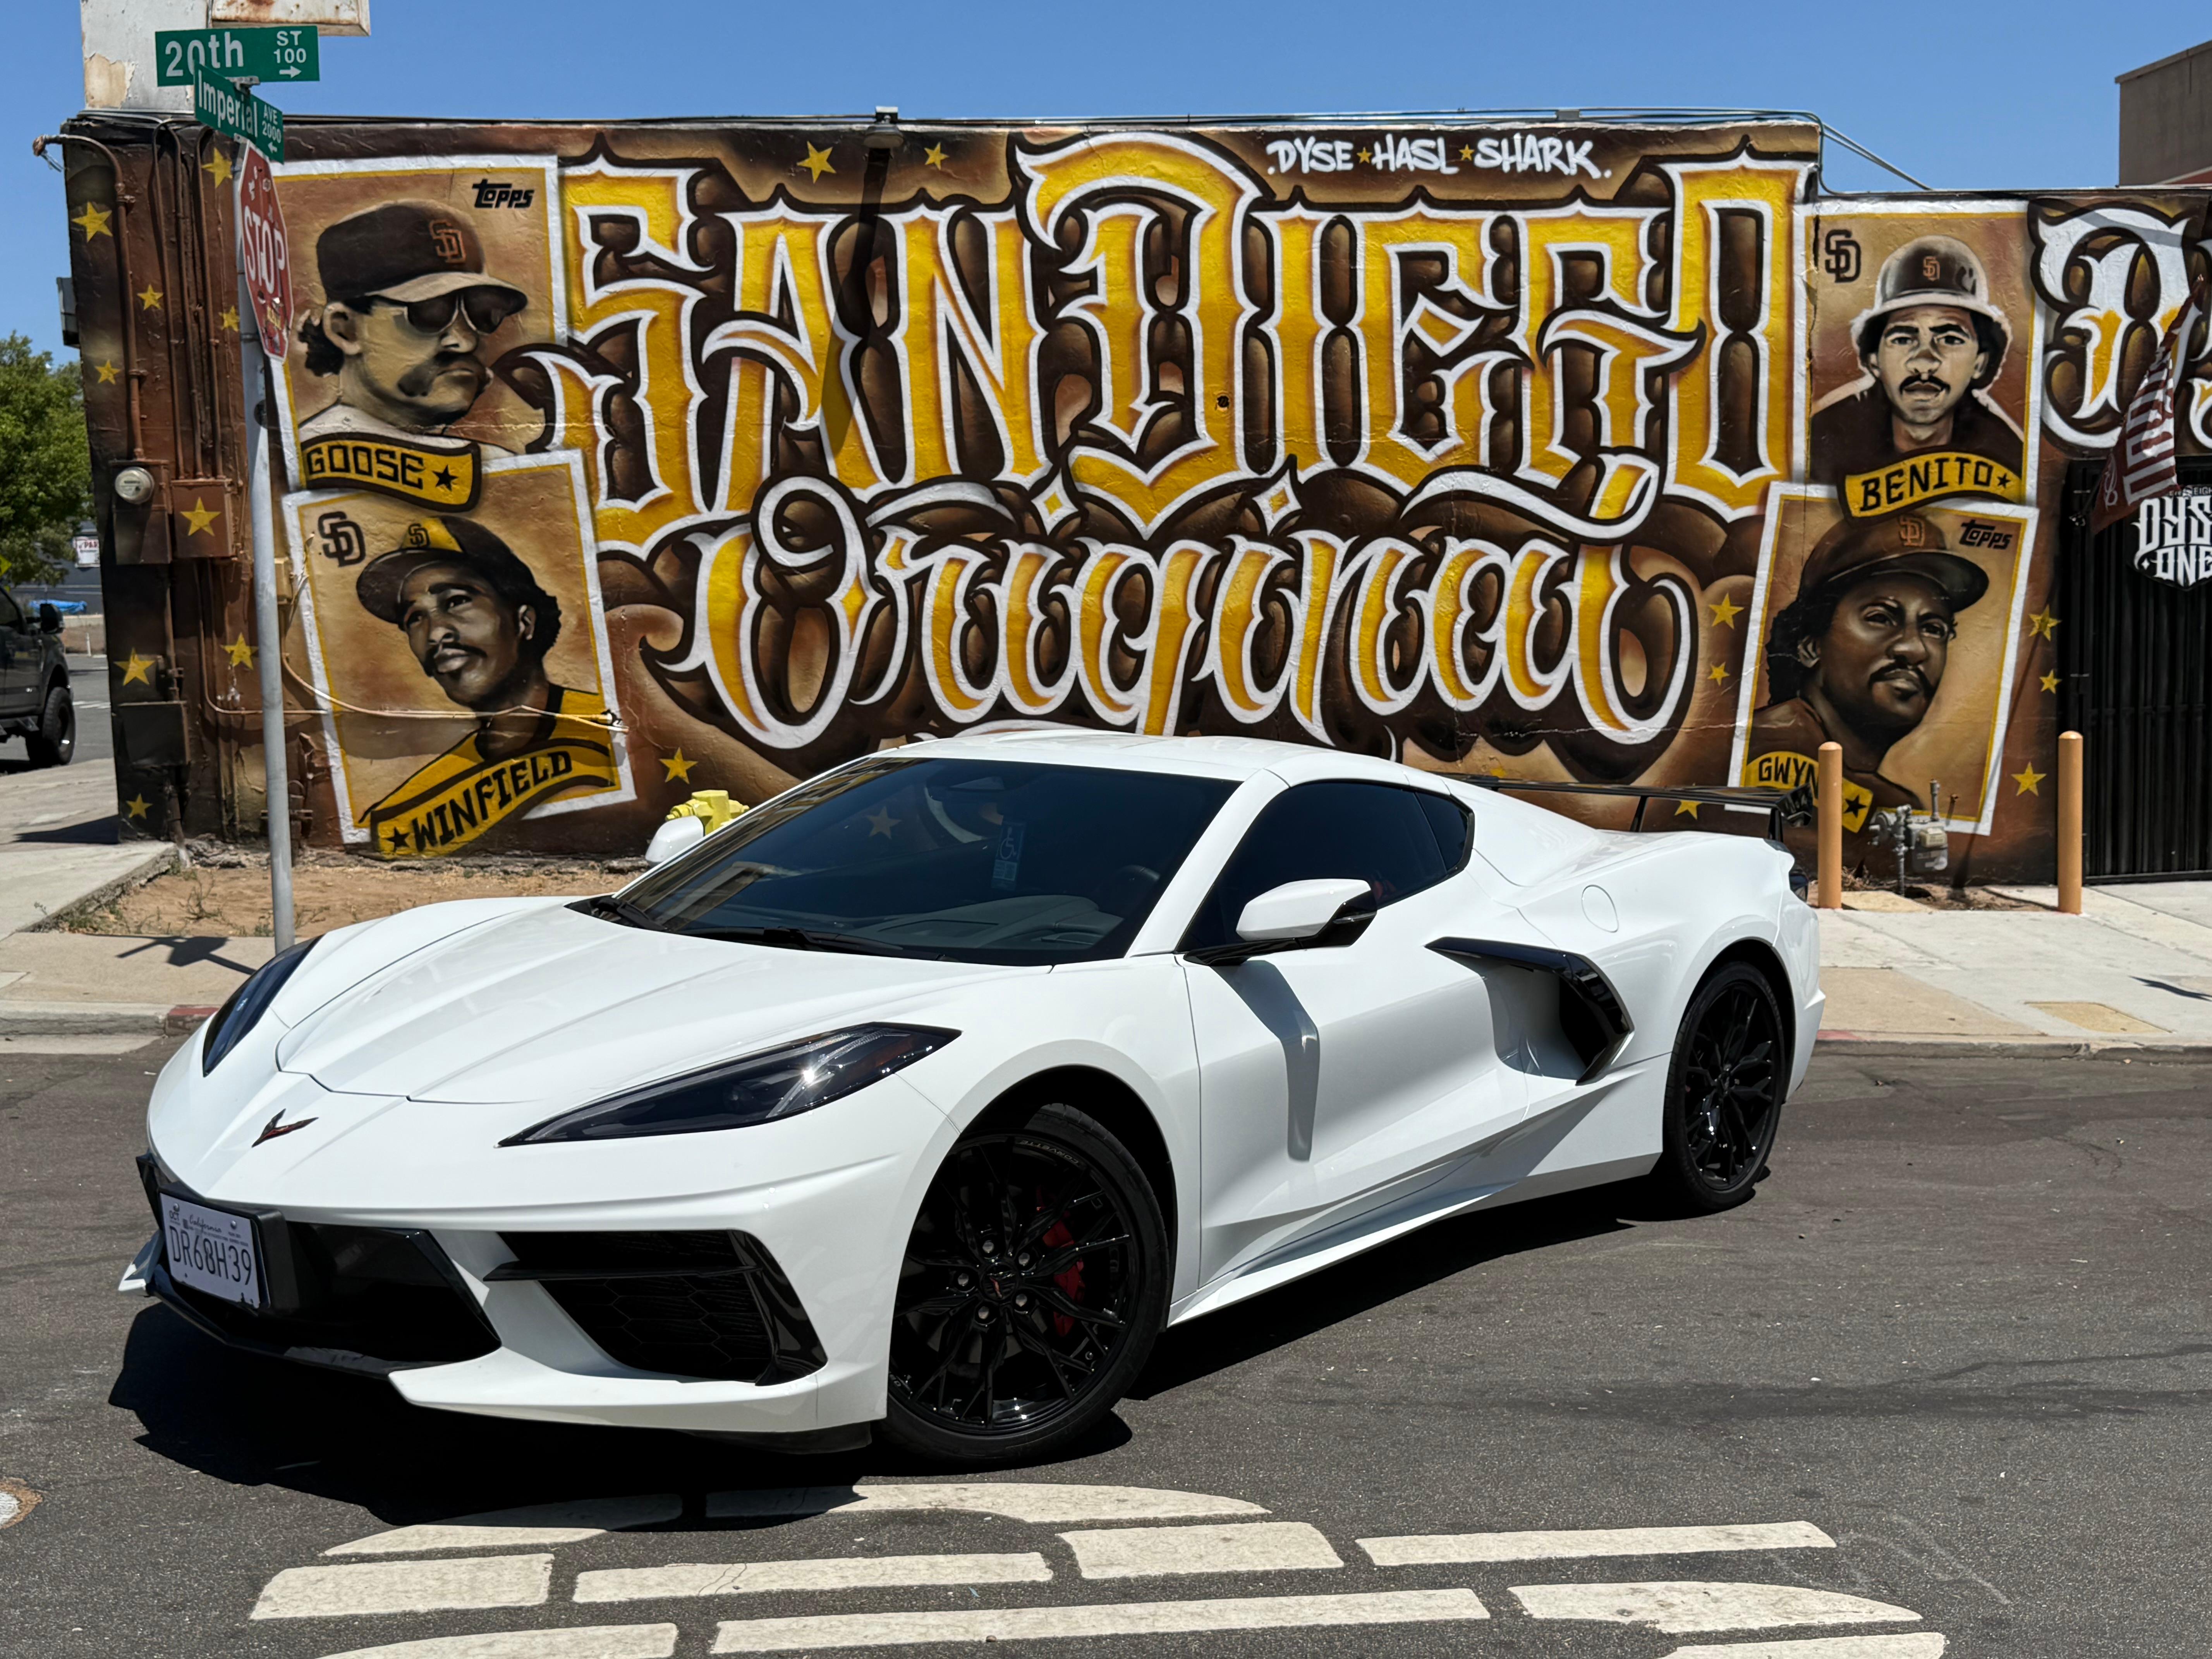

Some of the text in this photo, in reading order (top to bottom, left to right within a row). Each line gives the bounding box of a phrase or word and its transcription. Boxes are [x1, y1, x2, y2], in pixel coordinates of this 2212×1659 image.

[165, 31, 302, 77] 20th ST
[273, 48, 306, 64] 100
[198, 70, 278, 137] Imperial AVE
[262, 120, 282, 144] 2000
[1371, 133, 1460, 175] HASL
[244, 205, 285, 297] STOP
[306, 445, 426, 489] GOOSE
[1860, 454, 1994, 512] BENITO
[2130, 495, 2212, 570] DYS
[410, 750, 572, 852] WINFIELD
[1759, 756, 1819, 799] GWYN
[170, 1225, 252, 1285] DR68H39
